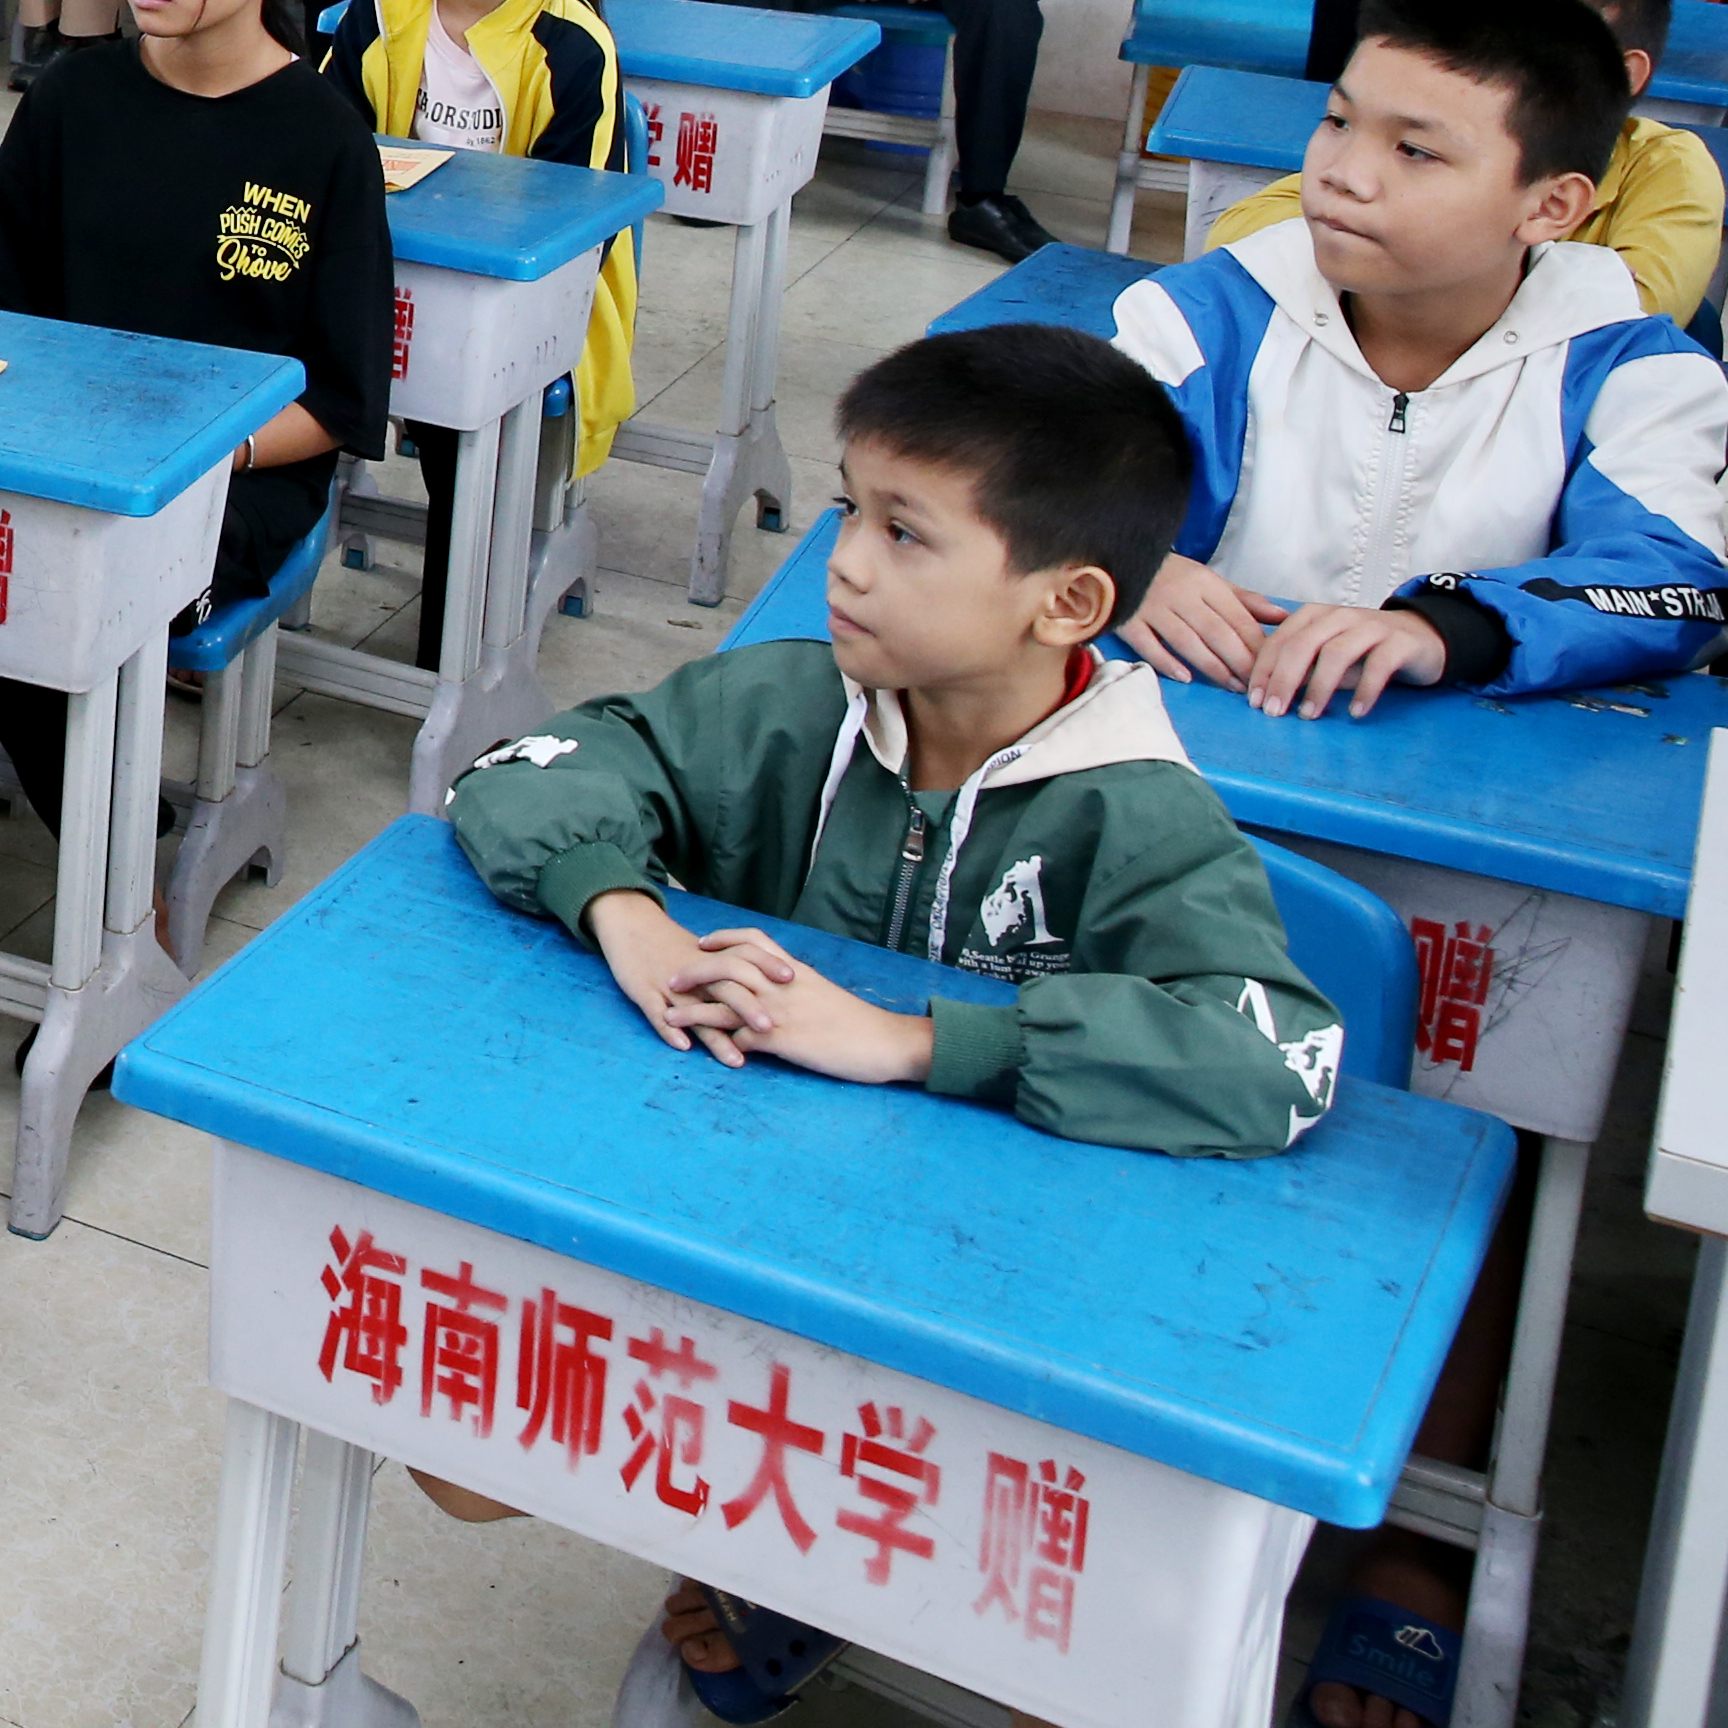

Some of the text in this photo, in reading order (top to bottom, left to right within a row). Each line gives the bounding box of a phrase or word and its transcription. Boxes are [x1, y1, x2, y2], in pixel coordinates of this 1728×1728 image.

[244, 181, 312, 223] WHEN
[220, 212, 311, 260] PUSH COMES
[251, 243, 268, 257] TO
[216, 238, 293, 282] Shove
[317, 1223, 1091, 1656] 海南师范大学 赠
